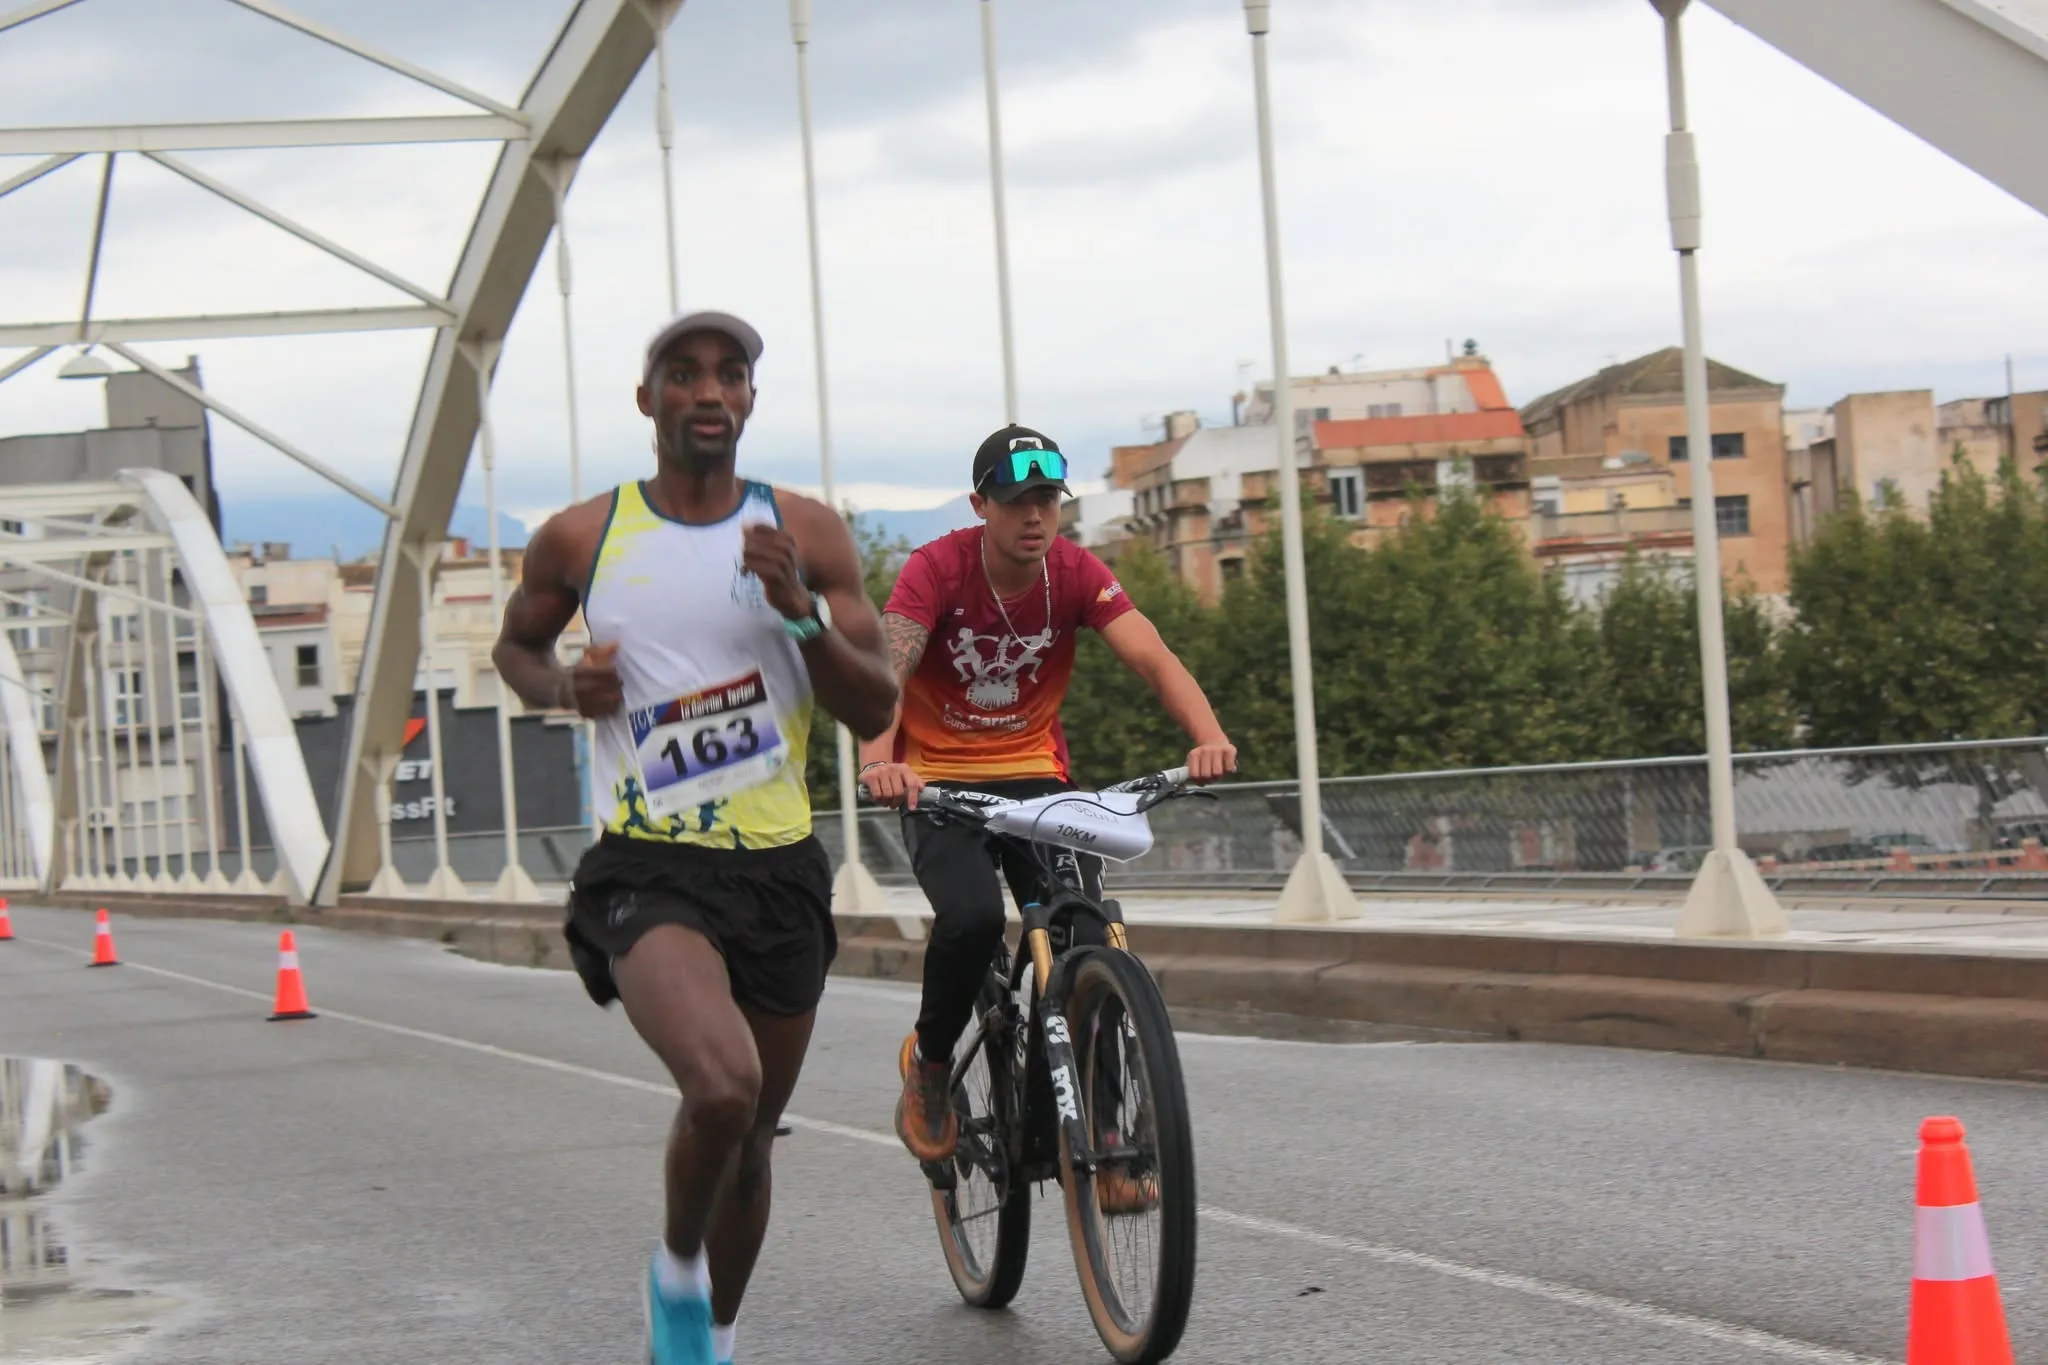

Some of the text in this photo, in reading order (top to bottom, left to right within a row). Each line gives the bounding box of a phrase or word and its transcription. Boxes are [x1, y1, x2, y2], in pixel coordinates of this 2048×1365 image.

[660, 715, 760, 777] 163
[395, 760, 433, 781] ET
[392, 797, 456, 820] ssFt
[1056, 823, 1097, 844] 10KM
[1051, 1065, 1079, 1126] FOX
